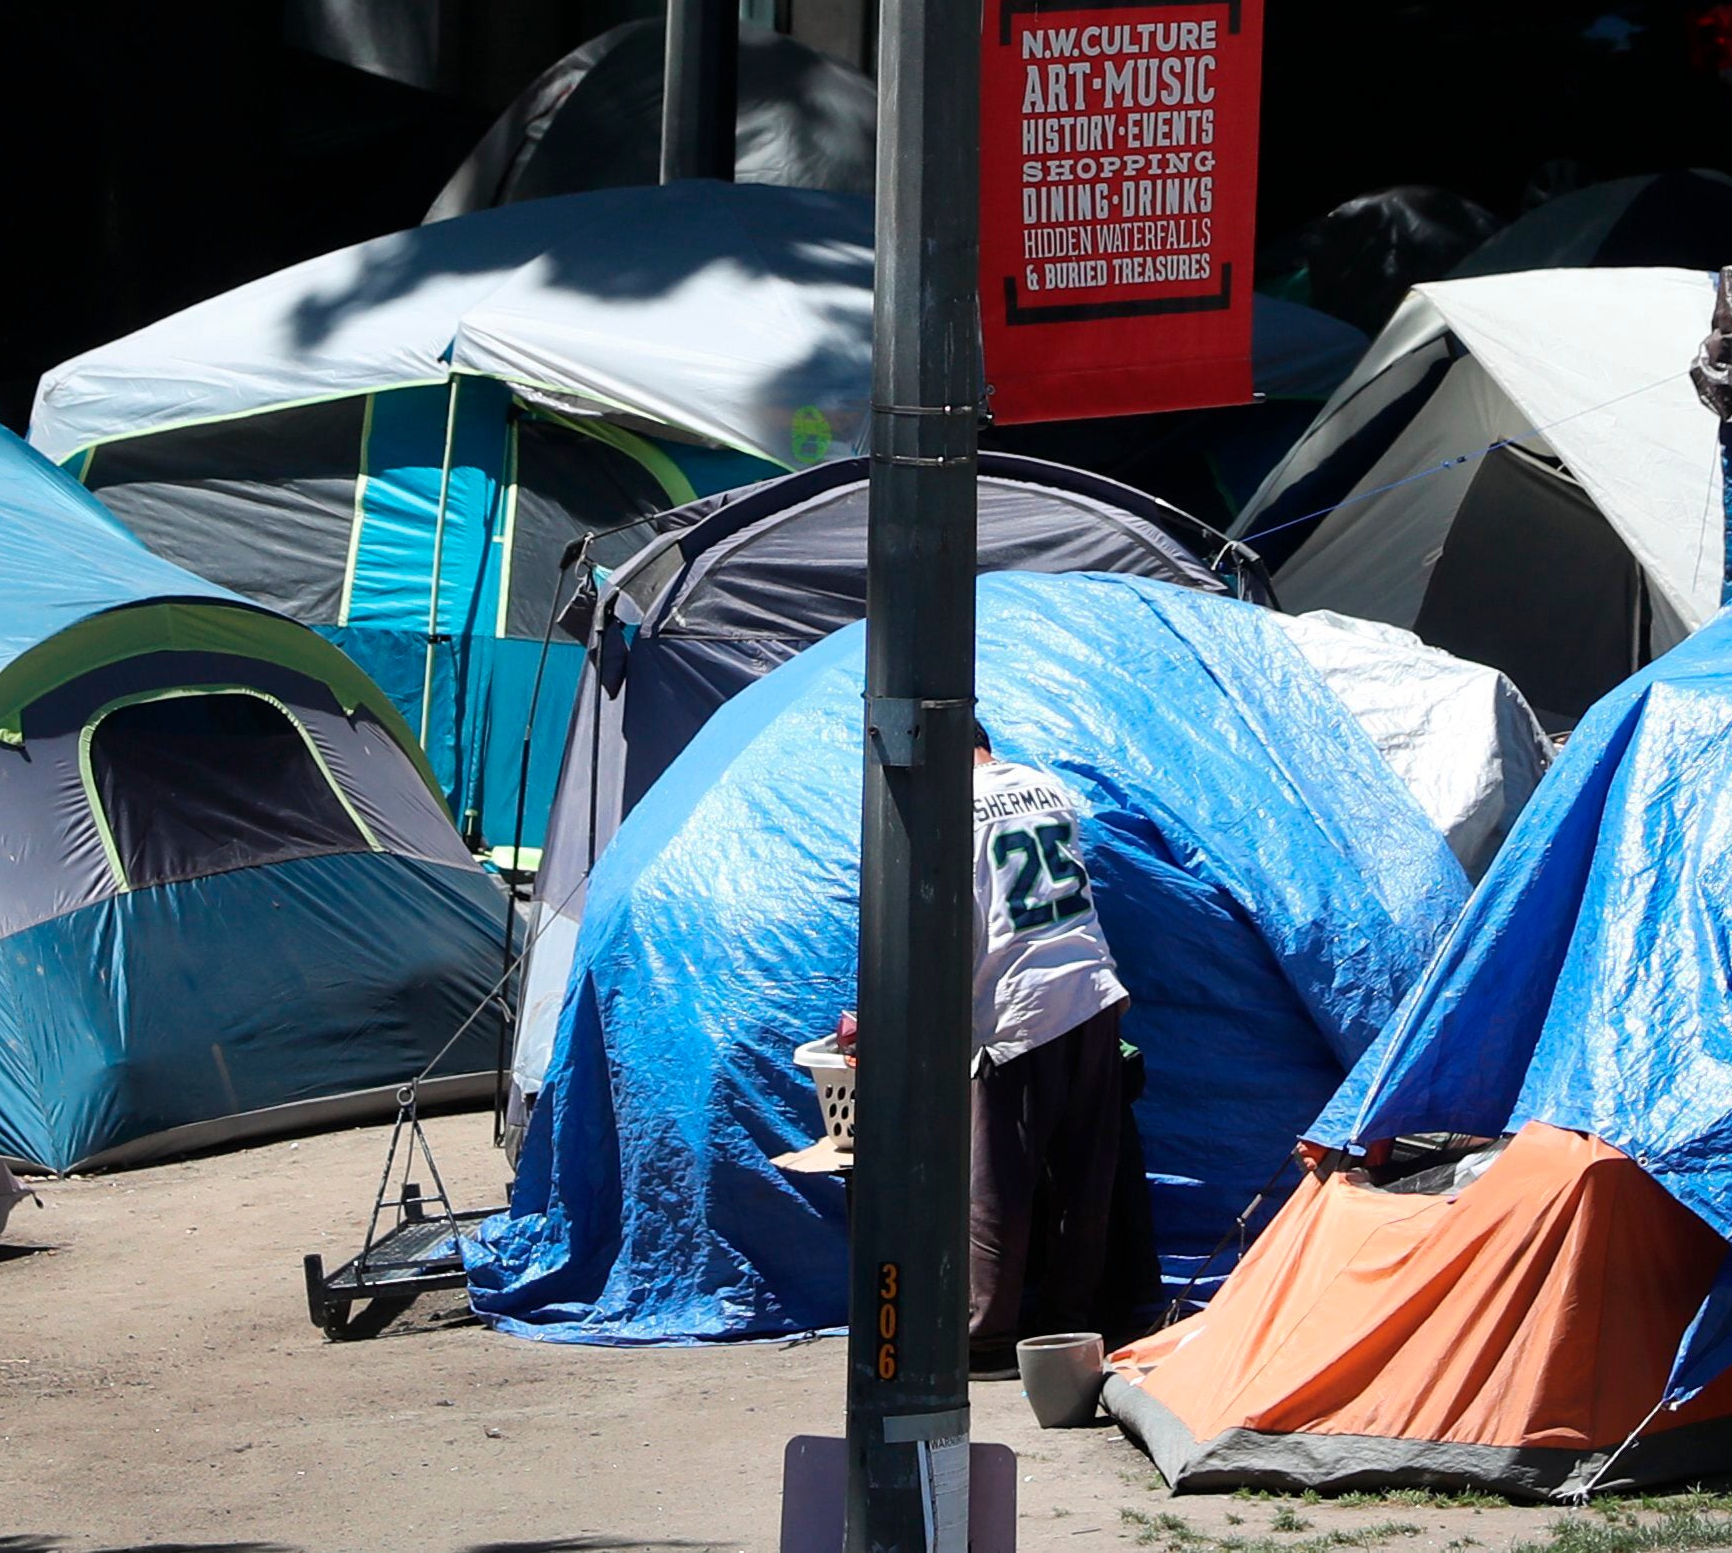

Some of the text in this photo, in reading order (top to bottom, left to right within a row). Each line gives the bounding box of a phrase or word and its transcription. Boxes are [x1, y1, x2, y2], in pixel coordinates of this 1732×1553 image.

[1022, 150, 1216, 183] SHOPPING
[1023, 218, 1211, 259] HIDDEN WATERFALLS
[1026, 253, 1210, 291] & BURIED TREASURES
[973, 787, 1063, 822] SHERMAN
[993, 823, 1092, 930] 25
[878, 1263, 897, 1379] 306
